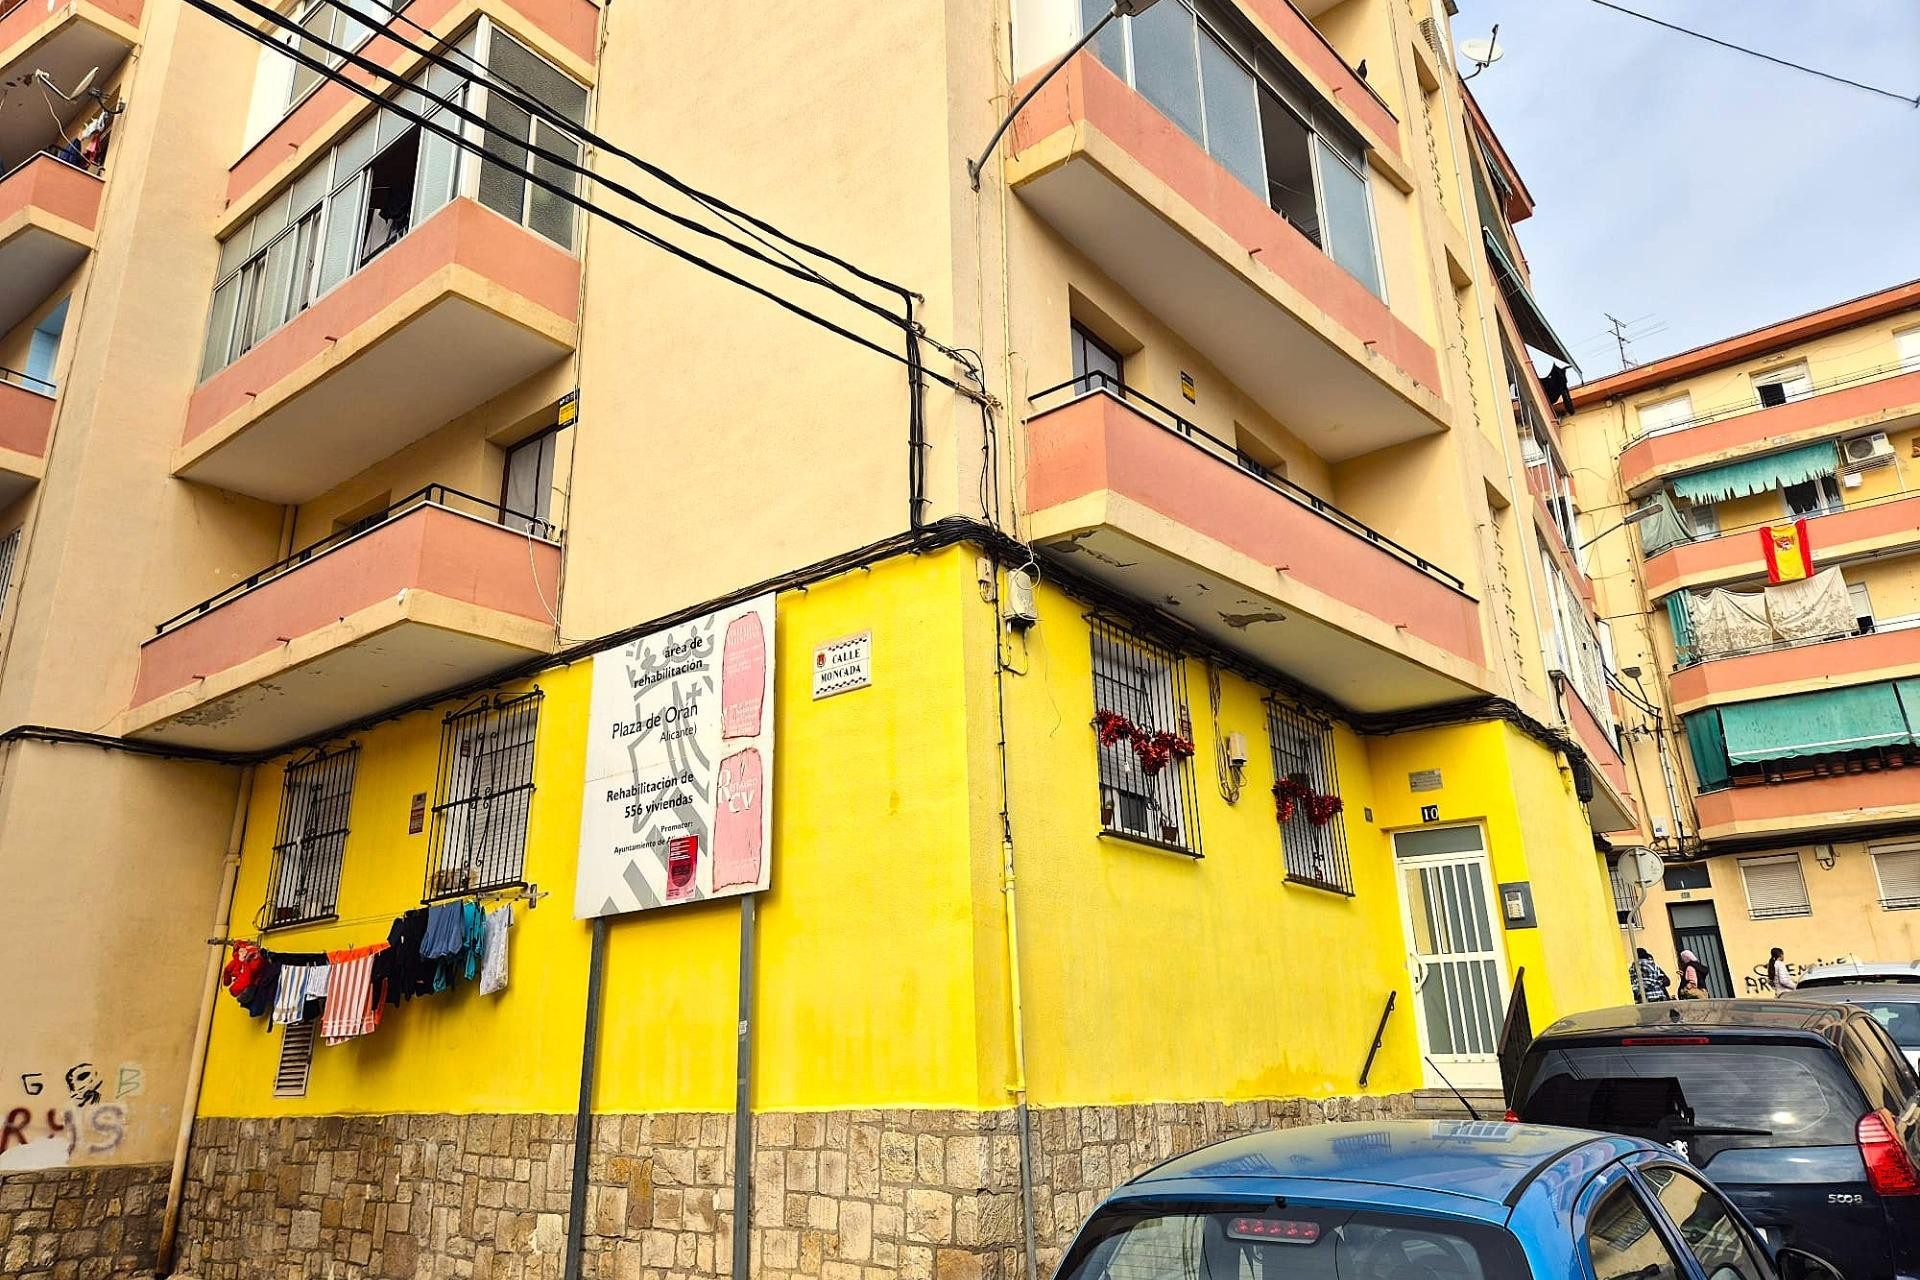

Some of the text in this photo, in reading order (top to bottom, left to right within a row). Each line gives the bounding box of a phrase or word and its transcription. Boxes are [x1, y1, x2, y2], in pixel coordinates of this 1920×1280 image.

[664, 637, 703, 659] área de
[832, 648, 861, 664] CALLE
[633, 659, 703, 688] rehabilitación
[821, 665, 861, 682] MONCADA
[612, 703, 698, 739] Plaza de Orán
[606, 771, 694, 802] Rehabilitación de
[624, 794, 693, 818] 556 viviendas
[1423, 807, 1438, 820] 10
[614, 841, 656, 855] Ayuntamiento
